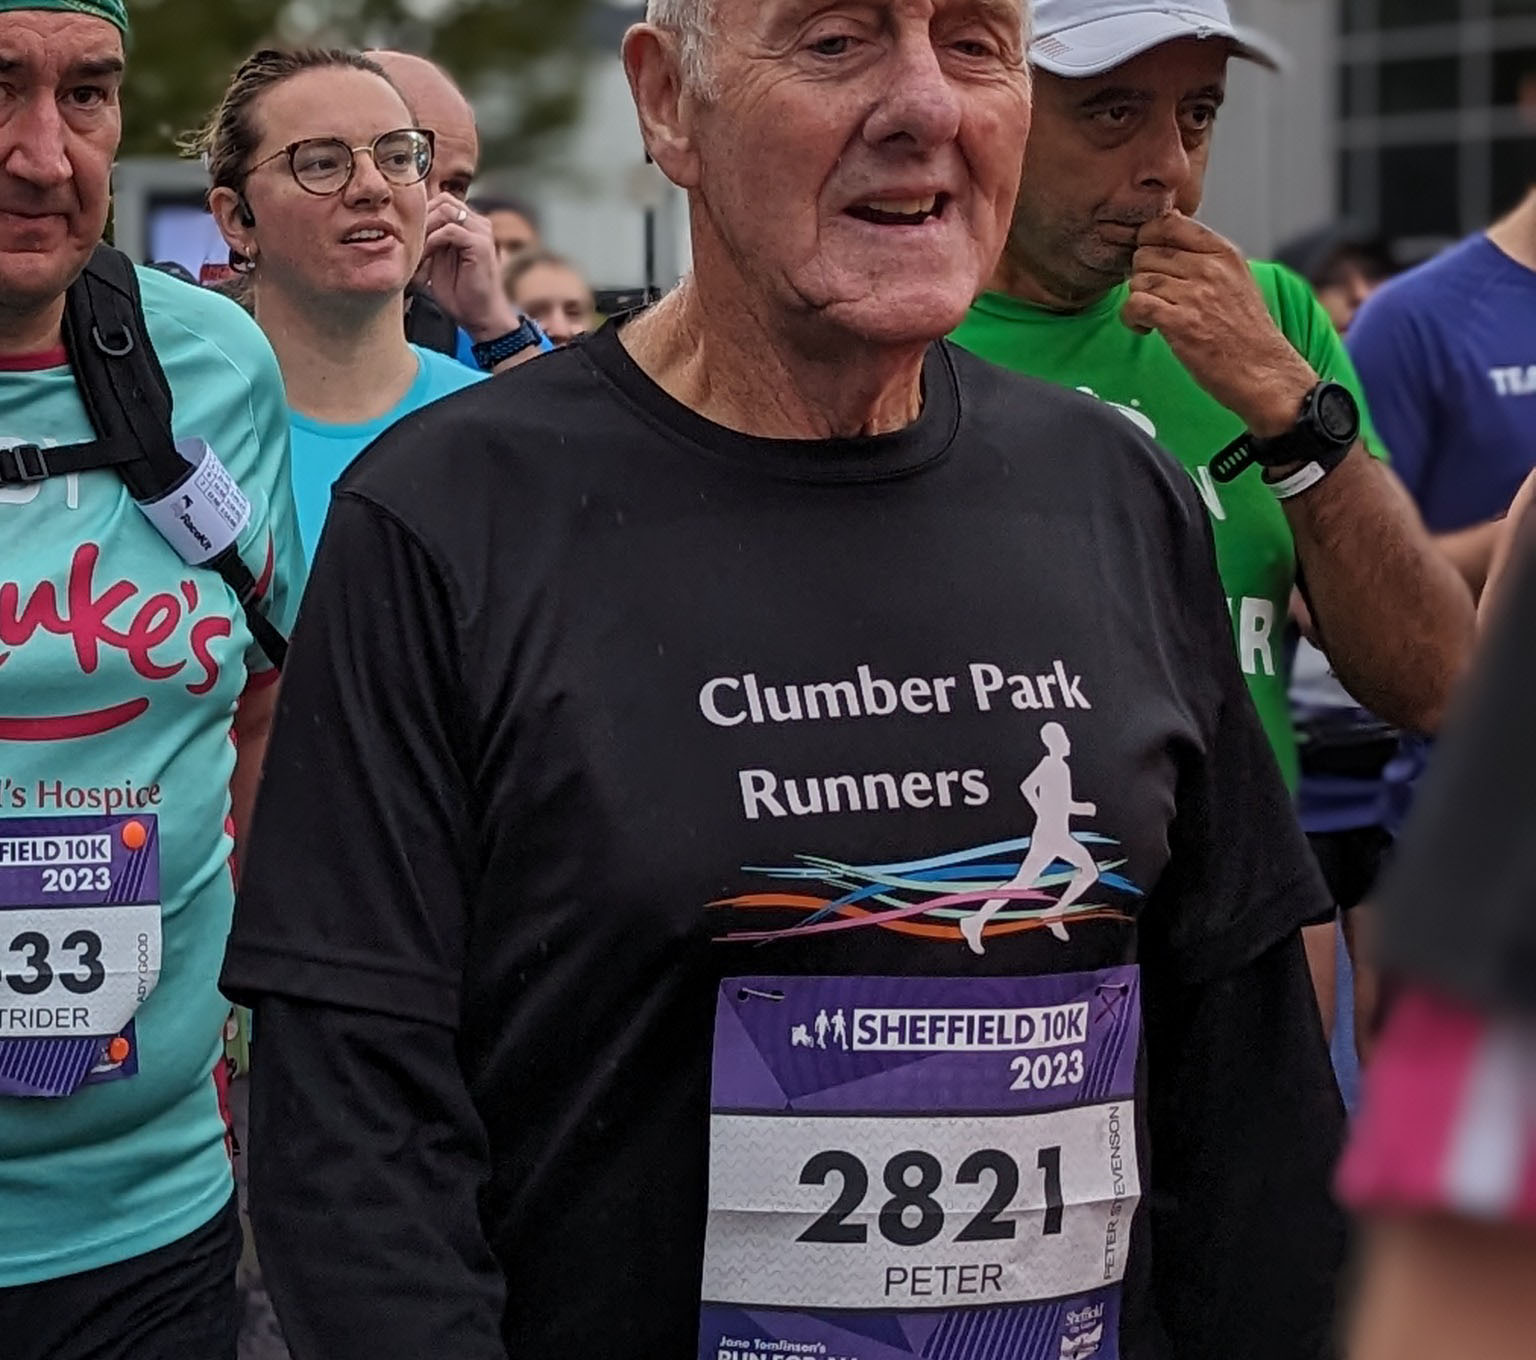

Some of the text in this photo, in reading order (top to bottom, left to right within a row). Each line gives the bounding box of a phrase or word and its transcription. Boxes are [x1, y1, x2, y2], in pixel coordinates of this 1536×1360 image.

[699, 659, 1092, 727] Clumber Park
[37, 778, 163, 816] Hospice
[738, 768, 991, 820] Runners
[64, 837, 110, 861] 10K
[41, 868, 112, 892] 2023
[138, 932, 149, 974] GOOD
[856, 1006, 1085, 1046] SHEFFIELD 10K
[1009, 1049, 1085, 1091] 2023
[794, 1145, 1063, 1247] 2821
[1102, 1105, 1126, 1280] PETER STEVENSON
[883, 1263, 1004, 1297] PETER
